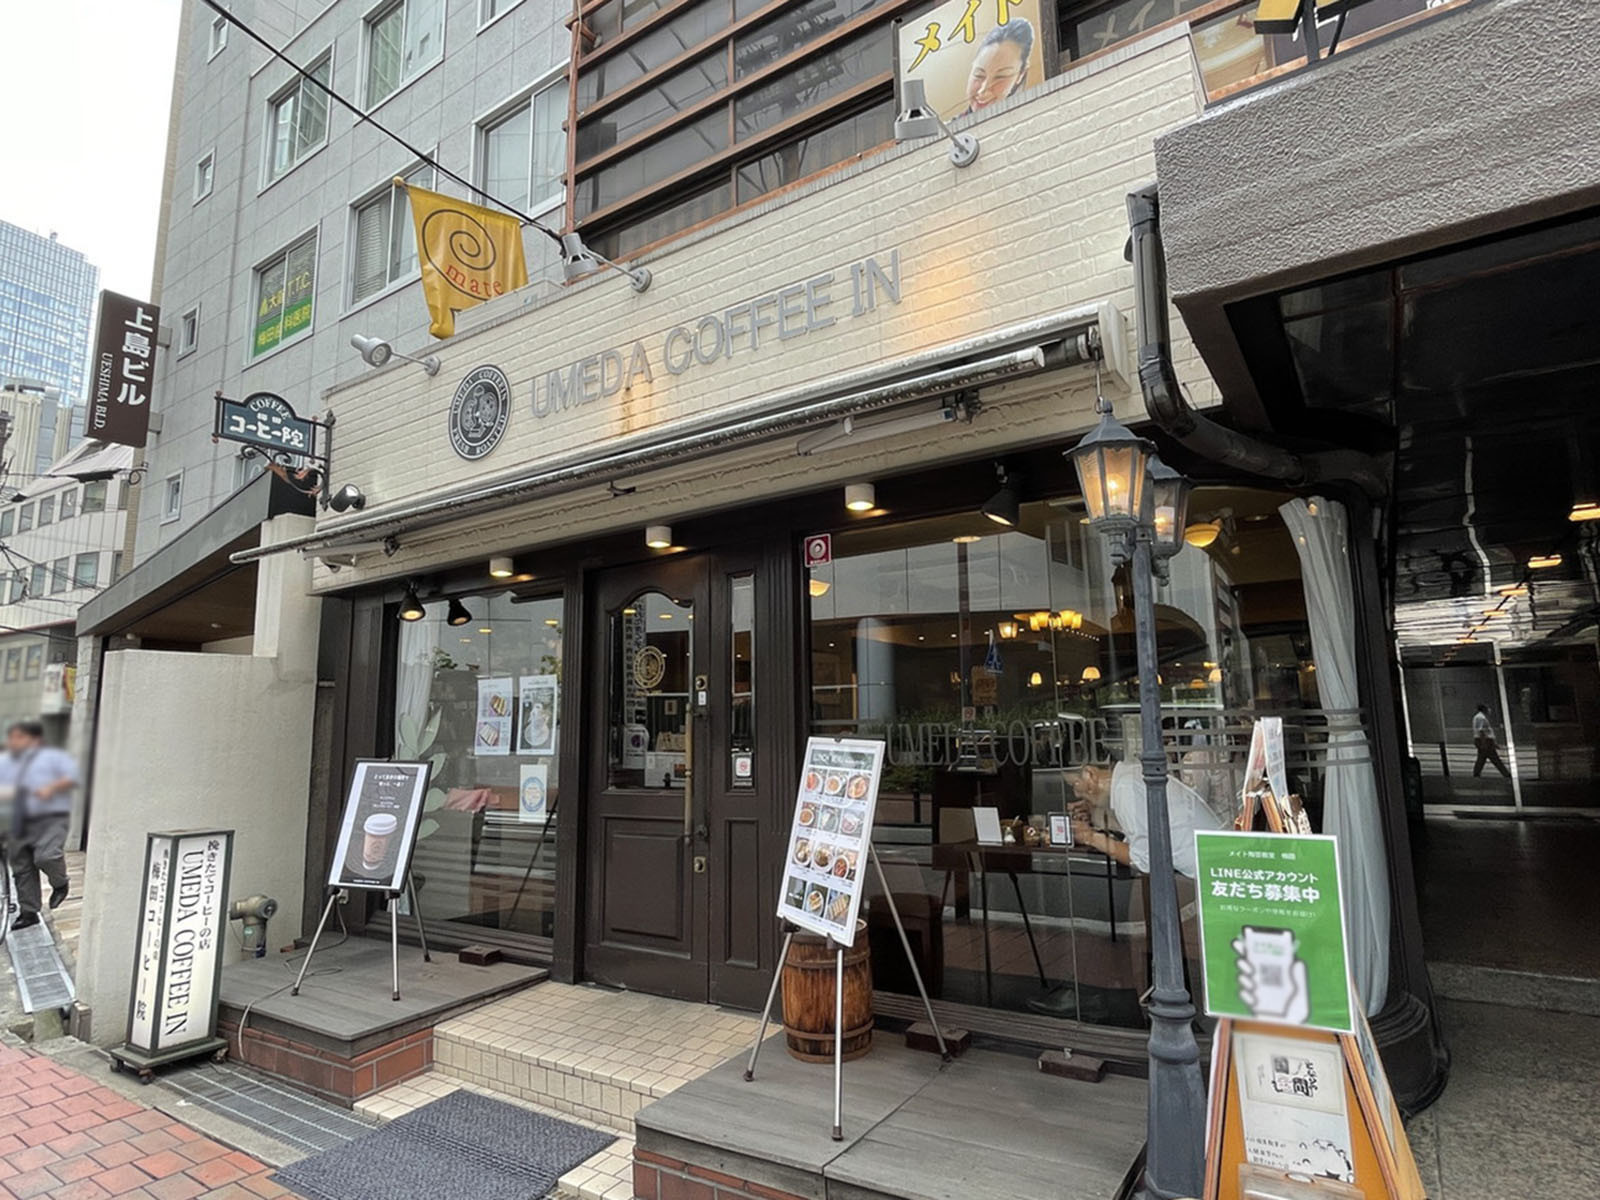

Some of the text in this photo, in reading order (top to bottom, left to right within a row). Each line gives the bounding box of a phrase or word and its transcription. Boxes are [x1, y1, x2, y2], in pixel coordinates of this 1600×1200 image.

[116, 306, 154, 406] 上島ビル
[531, 249, 902, 419] UMEDA COFFEE IN
[97, 352, 113, 404] UESHIMA
[250, 397, 292, 420] COFFEE
[1209, 866, 1319, 884] LINE公式アカウント
[1211, 880, 1321, 904] 友だち募集中
[164, 849, 205, 1037] UMEDA COFFEE IN
